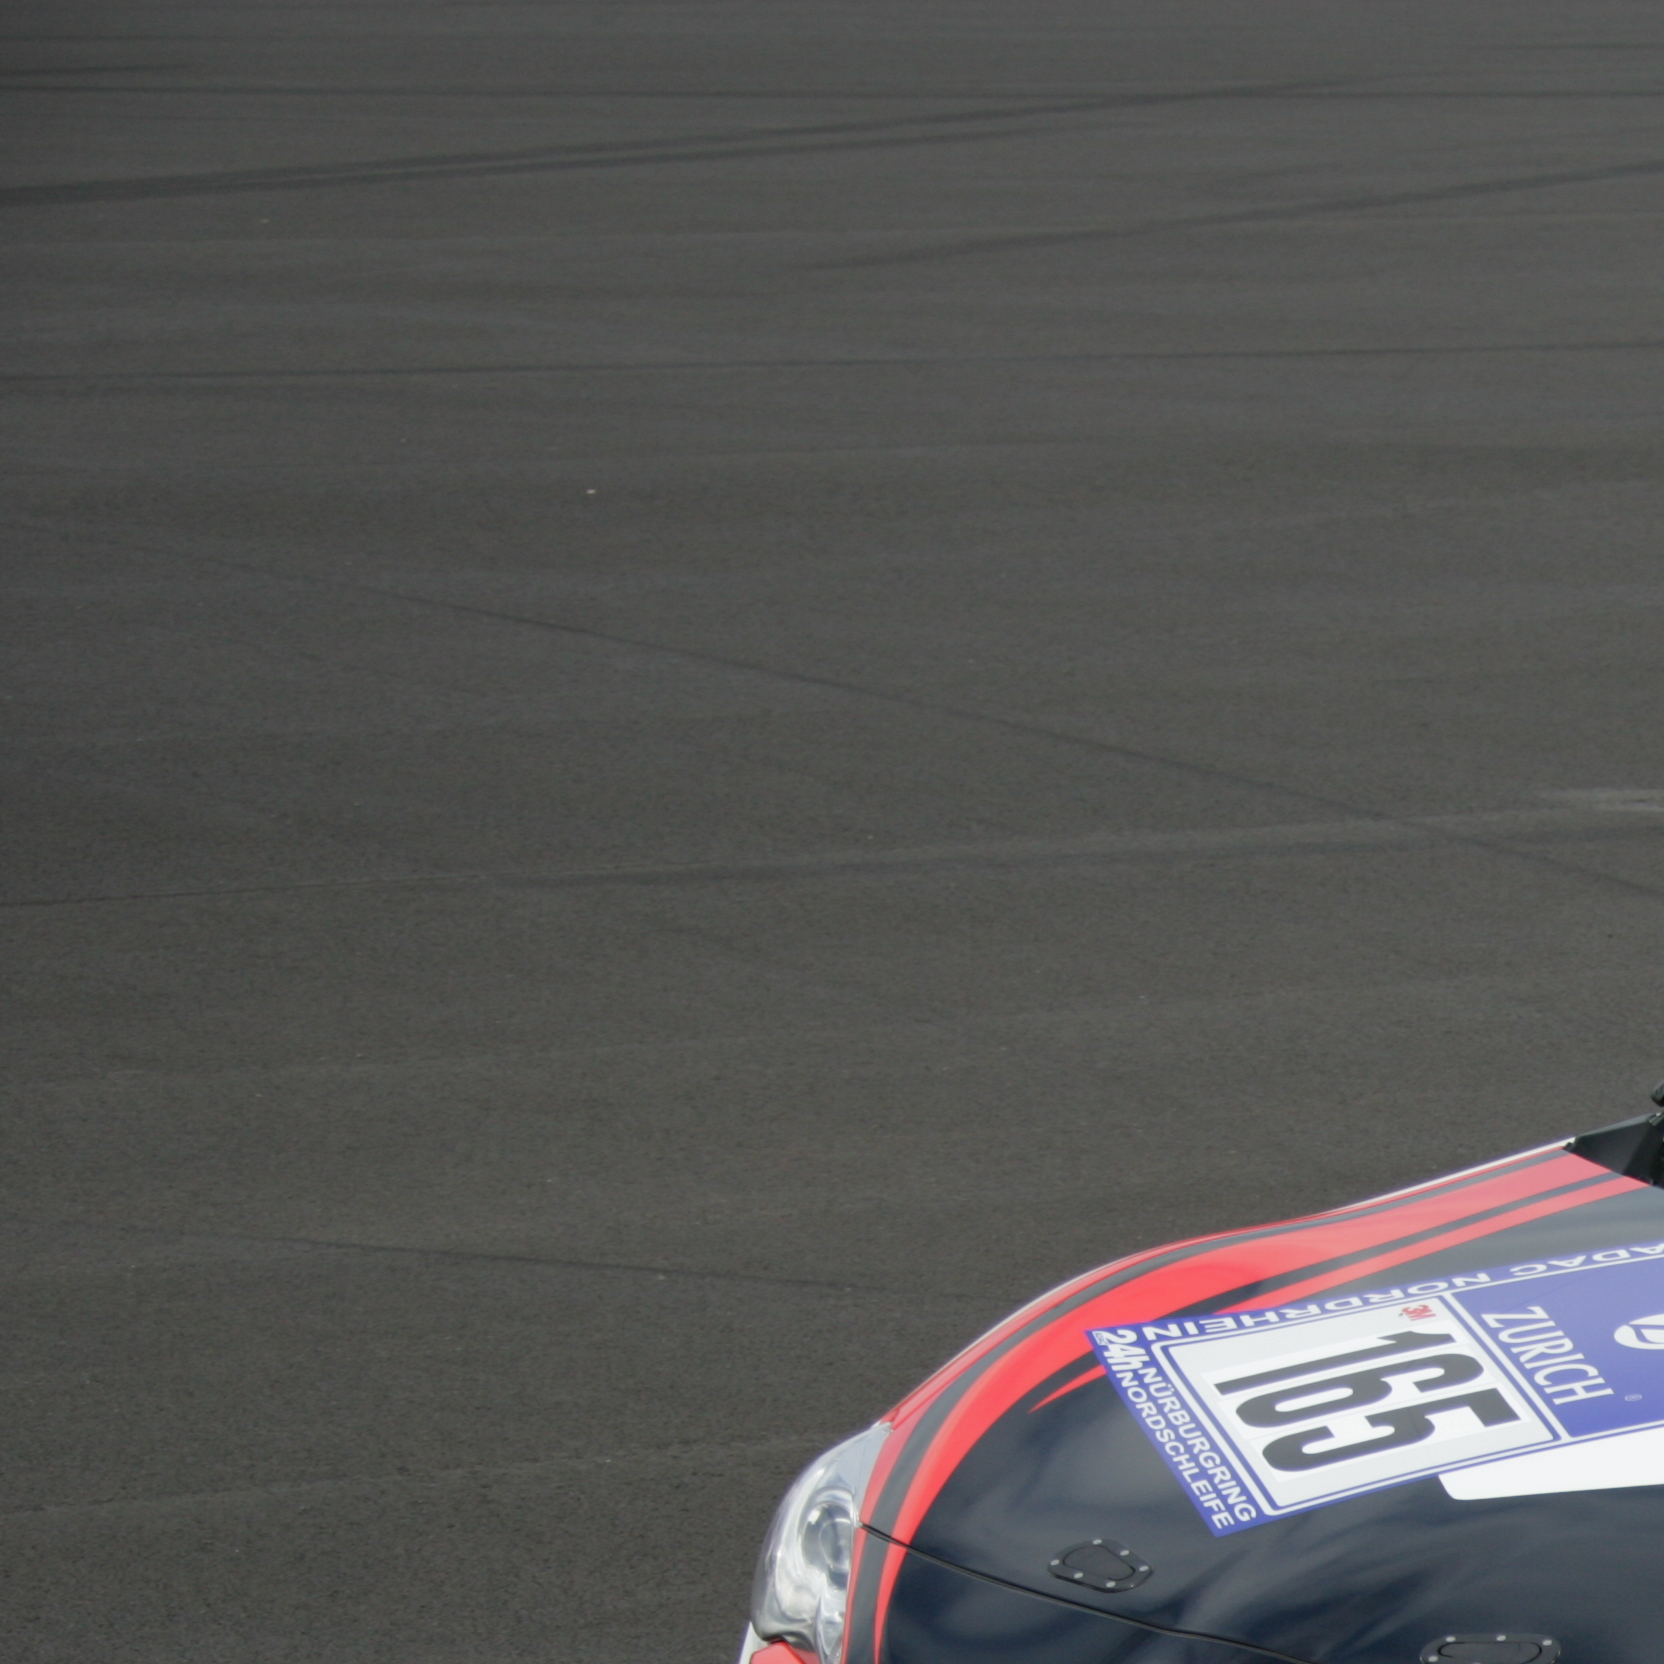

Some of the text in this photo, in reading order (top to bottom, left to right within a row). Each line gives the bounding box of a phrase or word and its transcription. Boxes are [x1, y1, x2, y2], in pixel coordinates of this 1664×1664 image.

[1098, 1328, 1150, 1372] 24h
[1141, 1271, 1492, 1341] NORDRHEIN
[1480, 1305, 1615, 1406] ZURICH
[1116, 1370, 1236, 1530] NORDSCHLEIFE
[1138, 1367, 1257, 1523] NÜRBURGRING
[1213, 1330, 1522, 1473] 165
